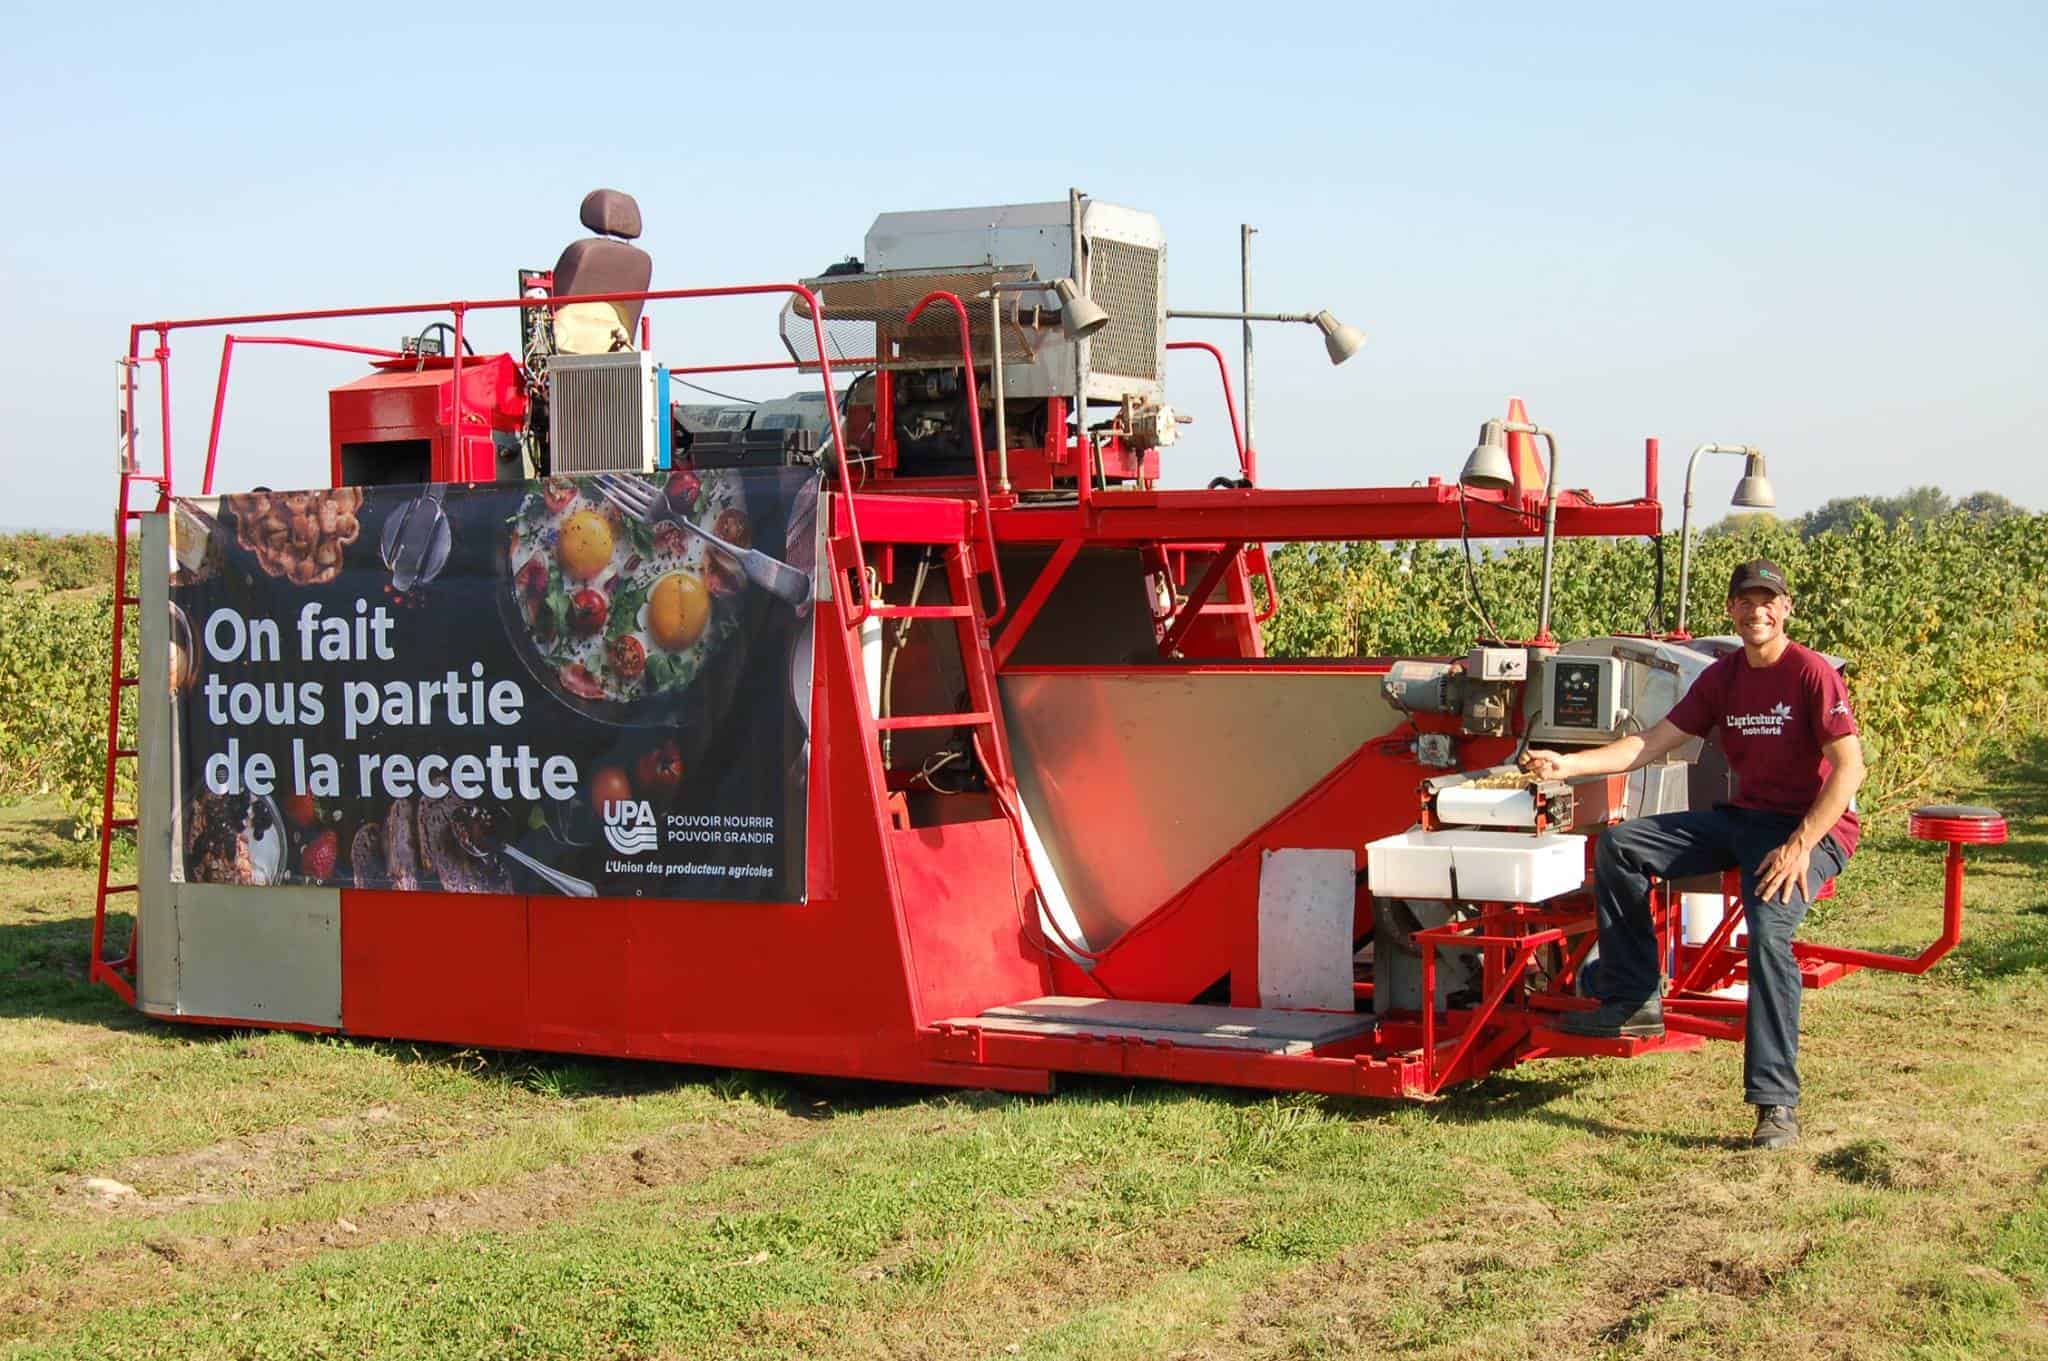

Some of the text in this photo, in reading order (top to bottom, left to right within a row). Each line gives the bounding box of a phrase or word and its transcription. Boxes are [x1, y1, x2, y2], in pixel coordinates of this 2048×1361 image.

[204, 599, 395, 662] On fait
[204, 662, 524, 740] tous partie
[205, 738, 579, 800] de la recette
[603, 799, 657, 826] UPA
[667, 815, 774, 828] POUVOIR NOURRIR
[668, 831, 774, 844] POUVOIR GRANDIR
[605, 860, 774, 879] L'Union des producteurs agricoles
